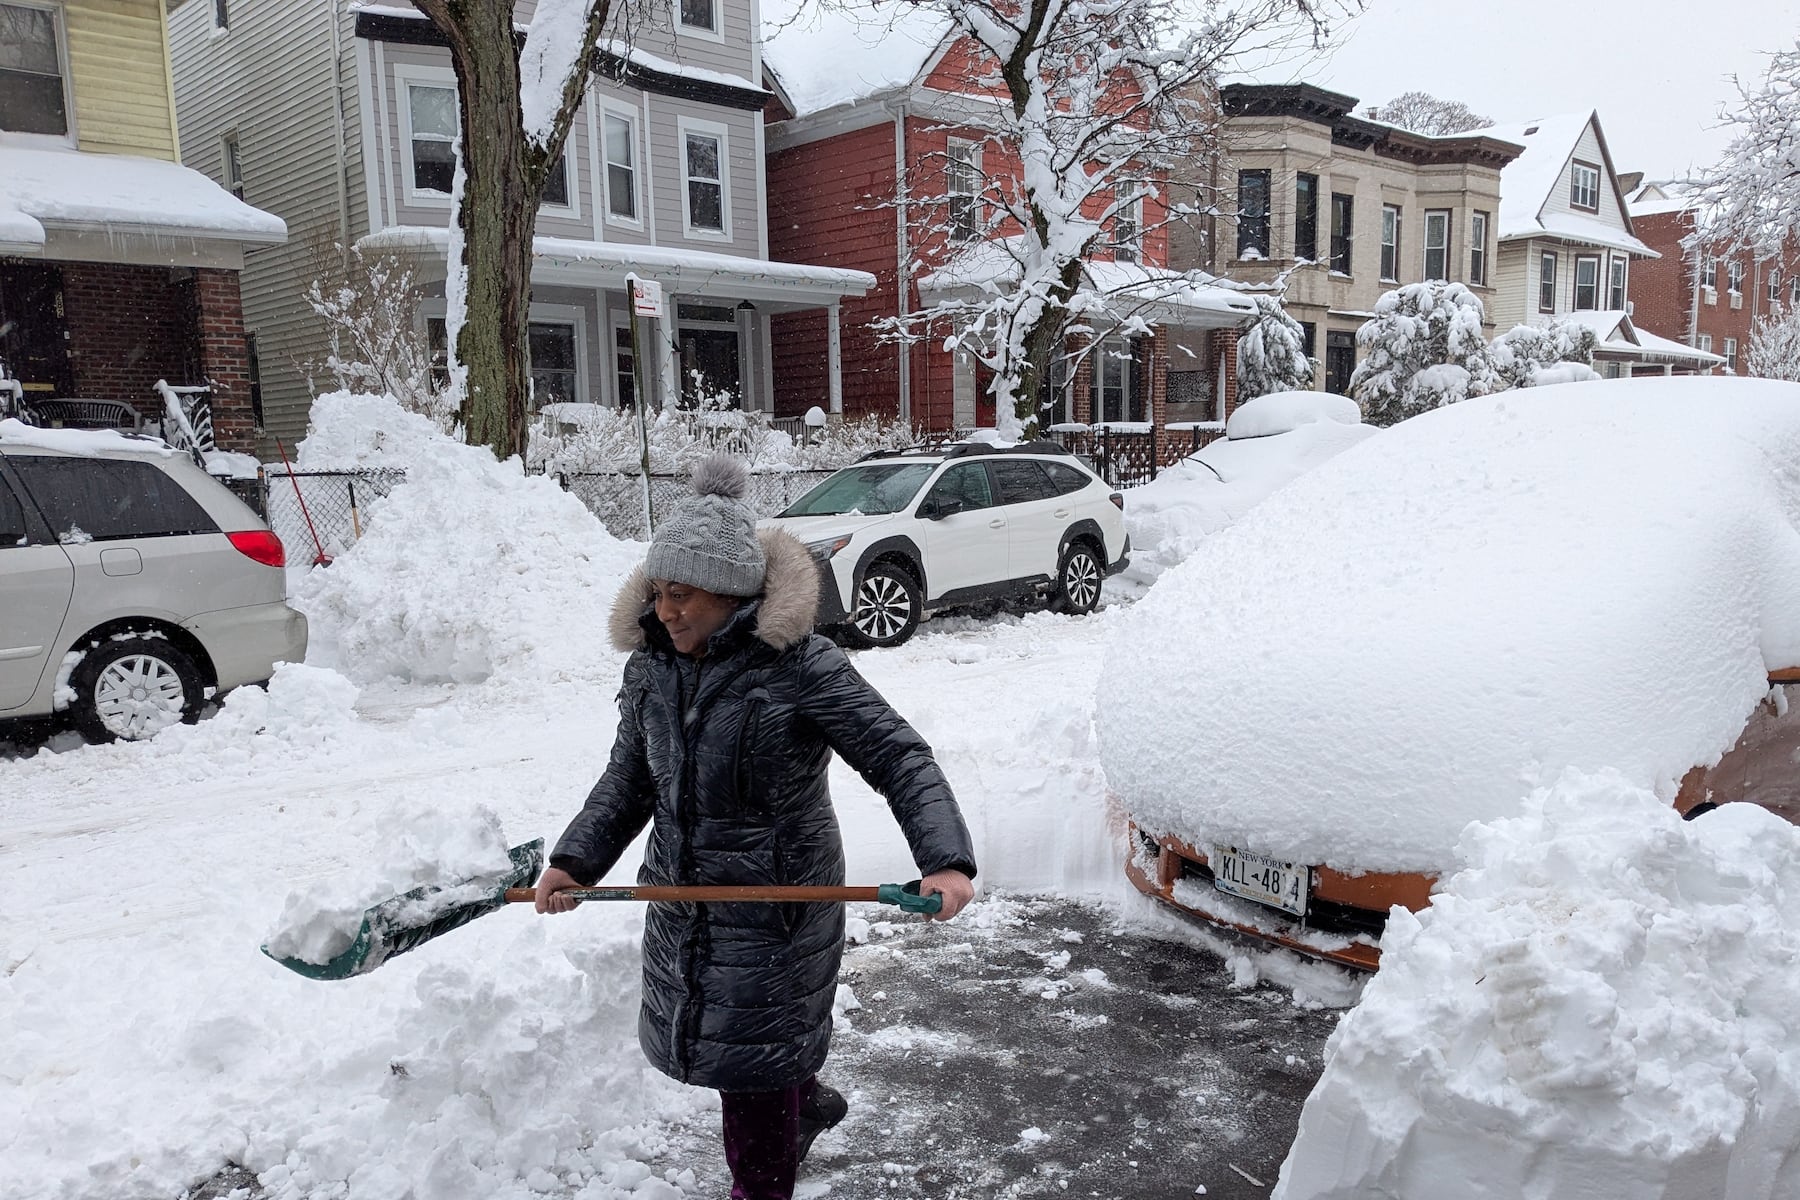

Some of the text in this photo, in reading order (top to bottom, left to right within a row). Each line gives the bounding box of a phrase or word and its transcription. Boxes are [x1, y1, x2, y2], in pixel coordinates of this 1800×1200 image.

[1238, 851, 1285, 871] NEW YORK
[1262, 868, 1299, 902] 484
